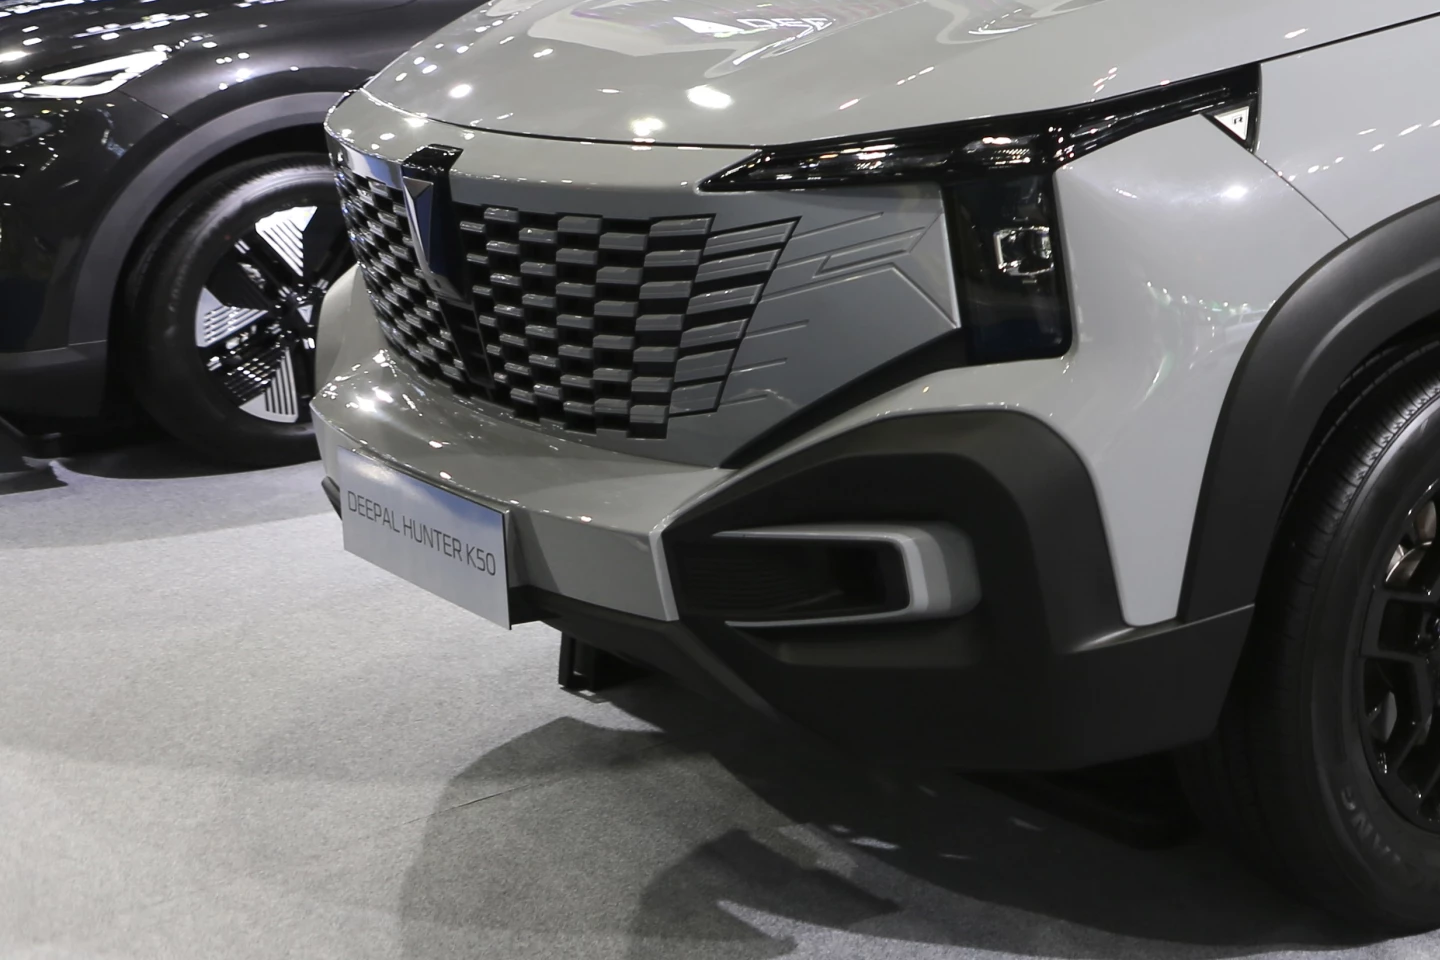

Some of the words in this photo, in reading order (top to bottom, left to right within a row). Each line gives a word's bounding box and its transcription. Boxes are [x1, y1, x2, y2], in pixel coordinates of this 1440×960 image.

[347, 490, 400, 533] DEEPAL
[402, 515, 463, 562] HUNTER
[465, 543, 496, 576] K50
